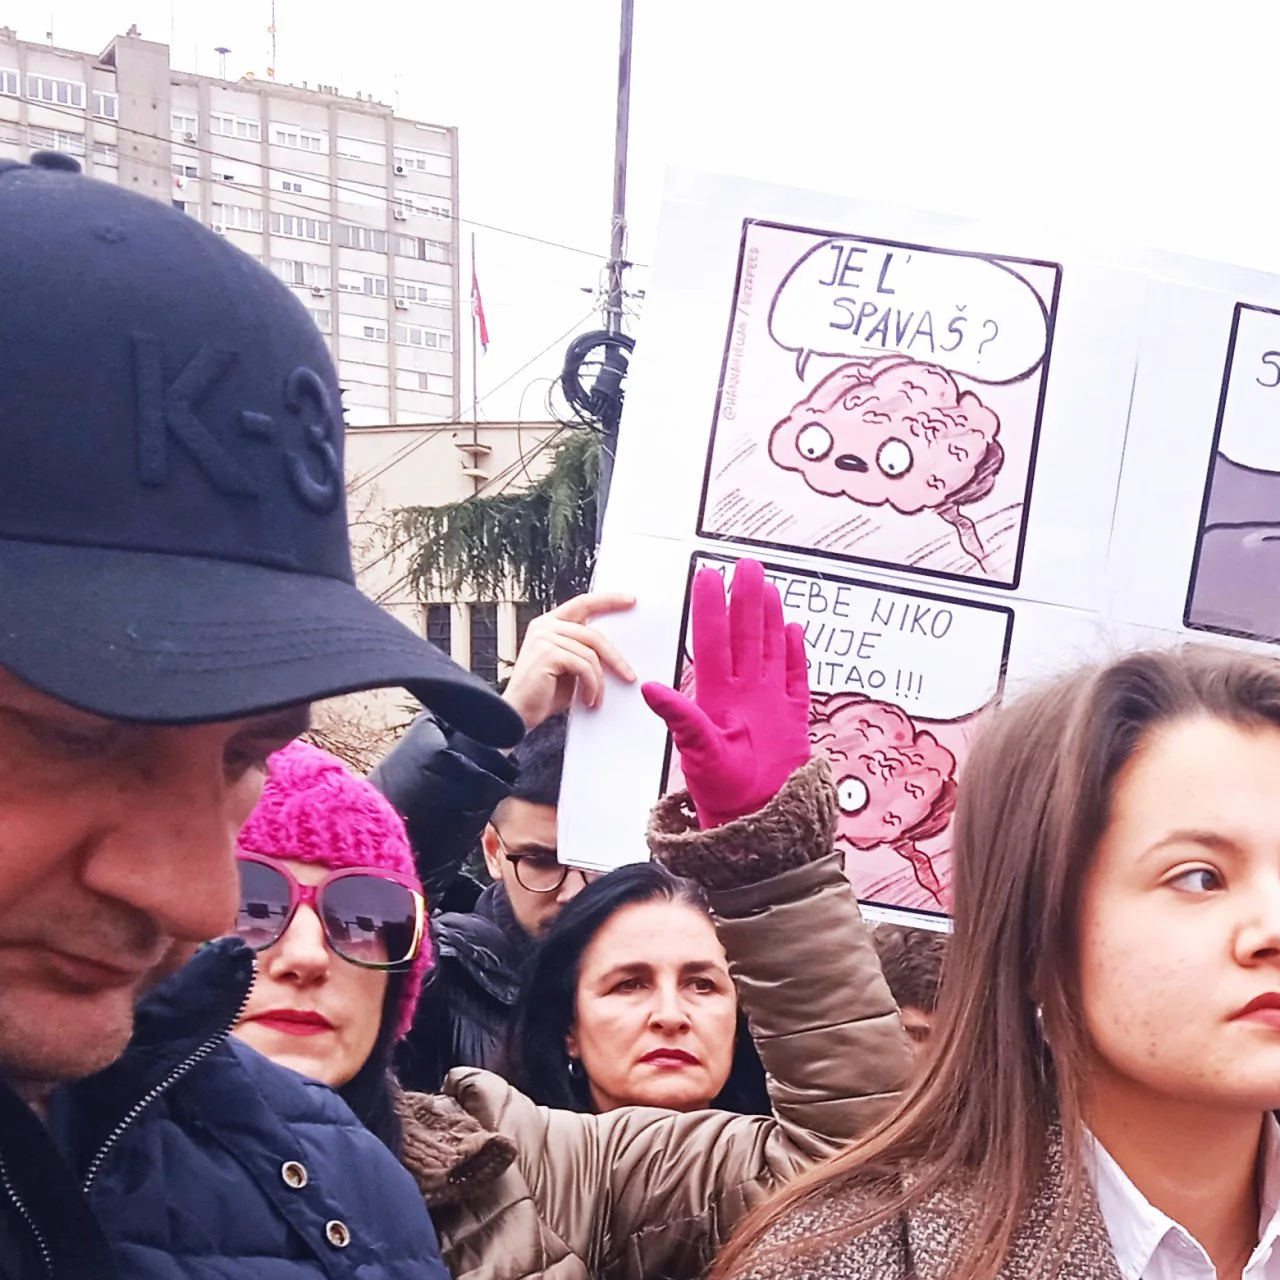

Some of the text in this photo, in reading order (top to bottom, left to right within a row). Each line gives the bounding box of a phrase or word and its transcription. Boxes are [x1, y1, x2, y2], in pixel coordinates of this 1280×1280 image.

[818, 244, 911, 294] JE L'
[131, 332, 341, 517] K-3
[803, 620, 882, 660] NIJE
[870, 597, 954, 640] NIKO
